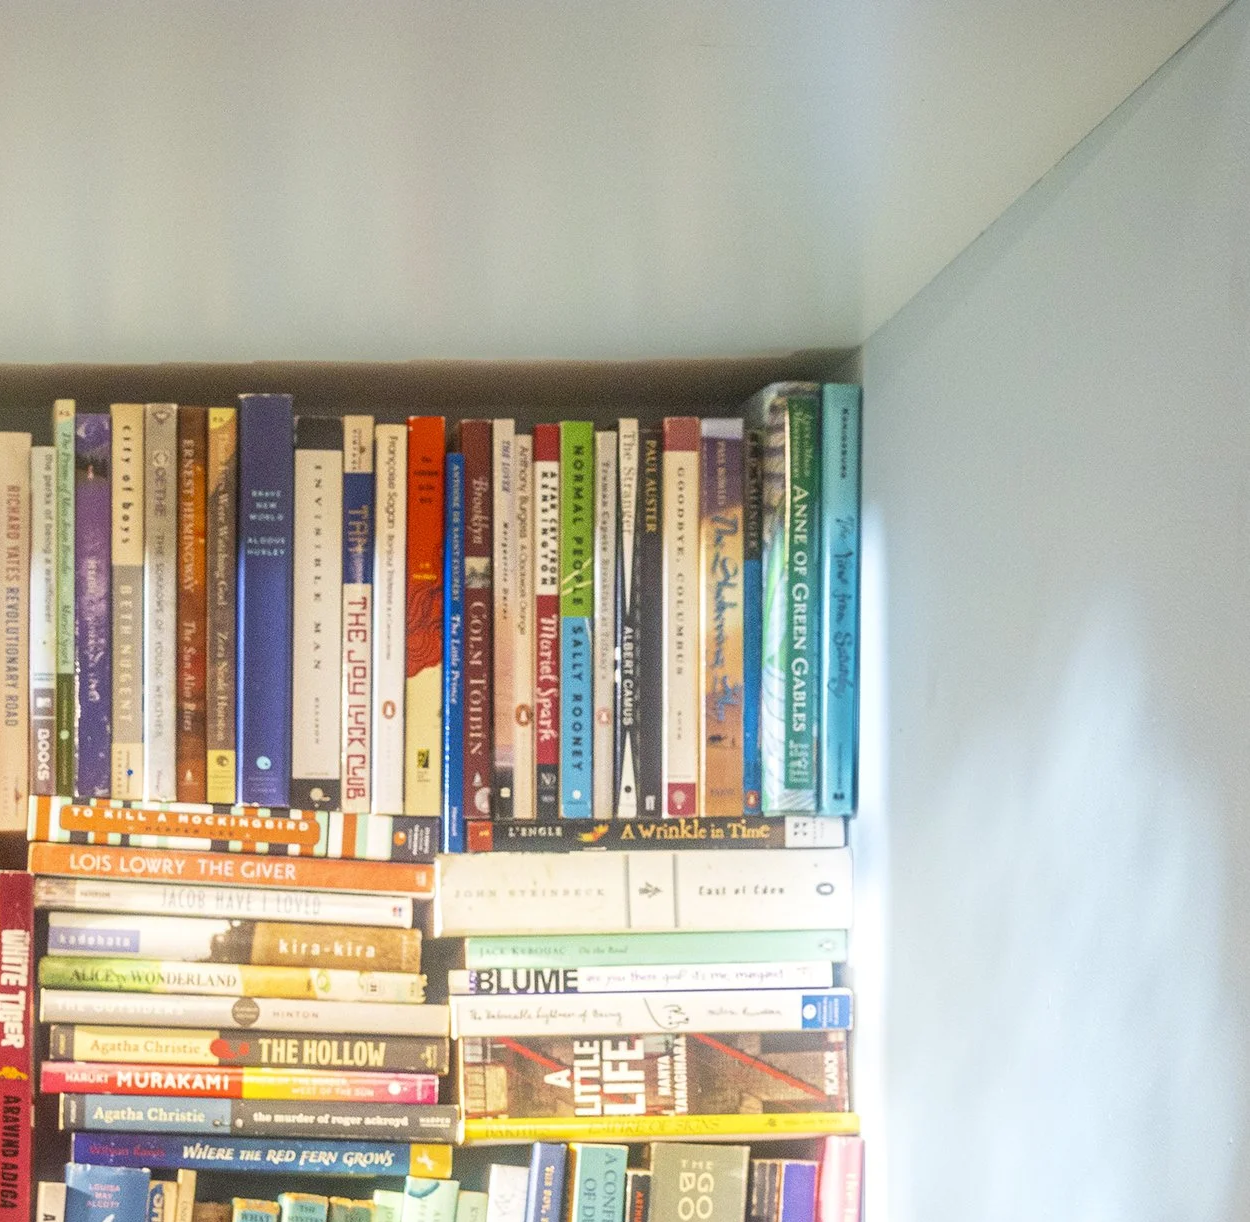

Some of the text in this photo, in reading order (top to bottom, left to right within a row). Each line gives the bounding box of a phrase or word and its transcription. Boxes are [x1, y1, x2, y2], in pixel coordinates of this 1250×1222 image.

[5, 485, 20, 726] RICHARD YATES REVOLUTIONARY ROAD
[571, 446, 584, 771] NORMAL PEOPLE SALLY ROONEY
[792, 485, 809, 732] ANNE OF GREEN GABLES
[469, 601, 487, 666] COLM
[536, 614, 557, 742] Muriel Spark
[623, 626, 633, 725] ALBERT CAMUS
[347, 597, 367, 799] THE JOY LUCK CLUB
[72, 808, 310, 832] TO KILL A MOCKINGBIRD
[621, 819, 770, 839] A Wrinkle in Time
[70, 853, 186, 875] LOIS LOWRY
[198, 858, 296, 881] THE GIVER
[1, 929, 29, 986] WHITE
[279, 938, 375, 958] kira-kira
[476, 969, 578, 993] BLUME
[259, 1038, 387, 1067] THE HOLLOW
[117, 1071, 229, 1091] MURAKAMI
[544, 1069, 571, 1089] A
[574, 1040, 600, 1116] LITTLE
[603, 1039, 645, 1115] LIFE
[253, 1112, 409, 1127] the murder of roger ackroyd
[0, 1096, 24, 1209] ARAVIND ADIGA
[184, 1143, 393, 1167] WHERE THE RED FERN GROWS
[602, 1153, 616, 1166] A
[583, 1178, 597, 1200] OF
